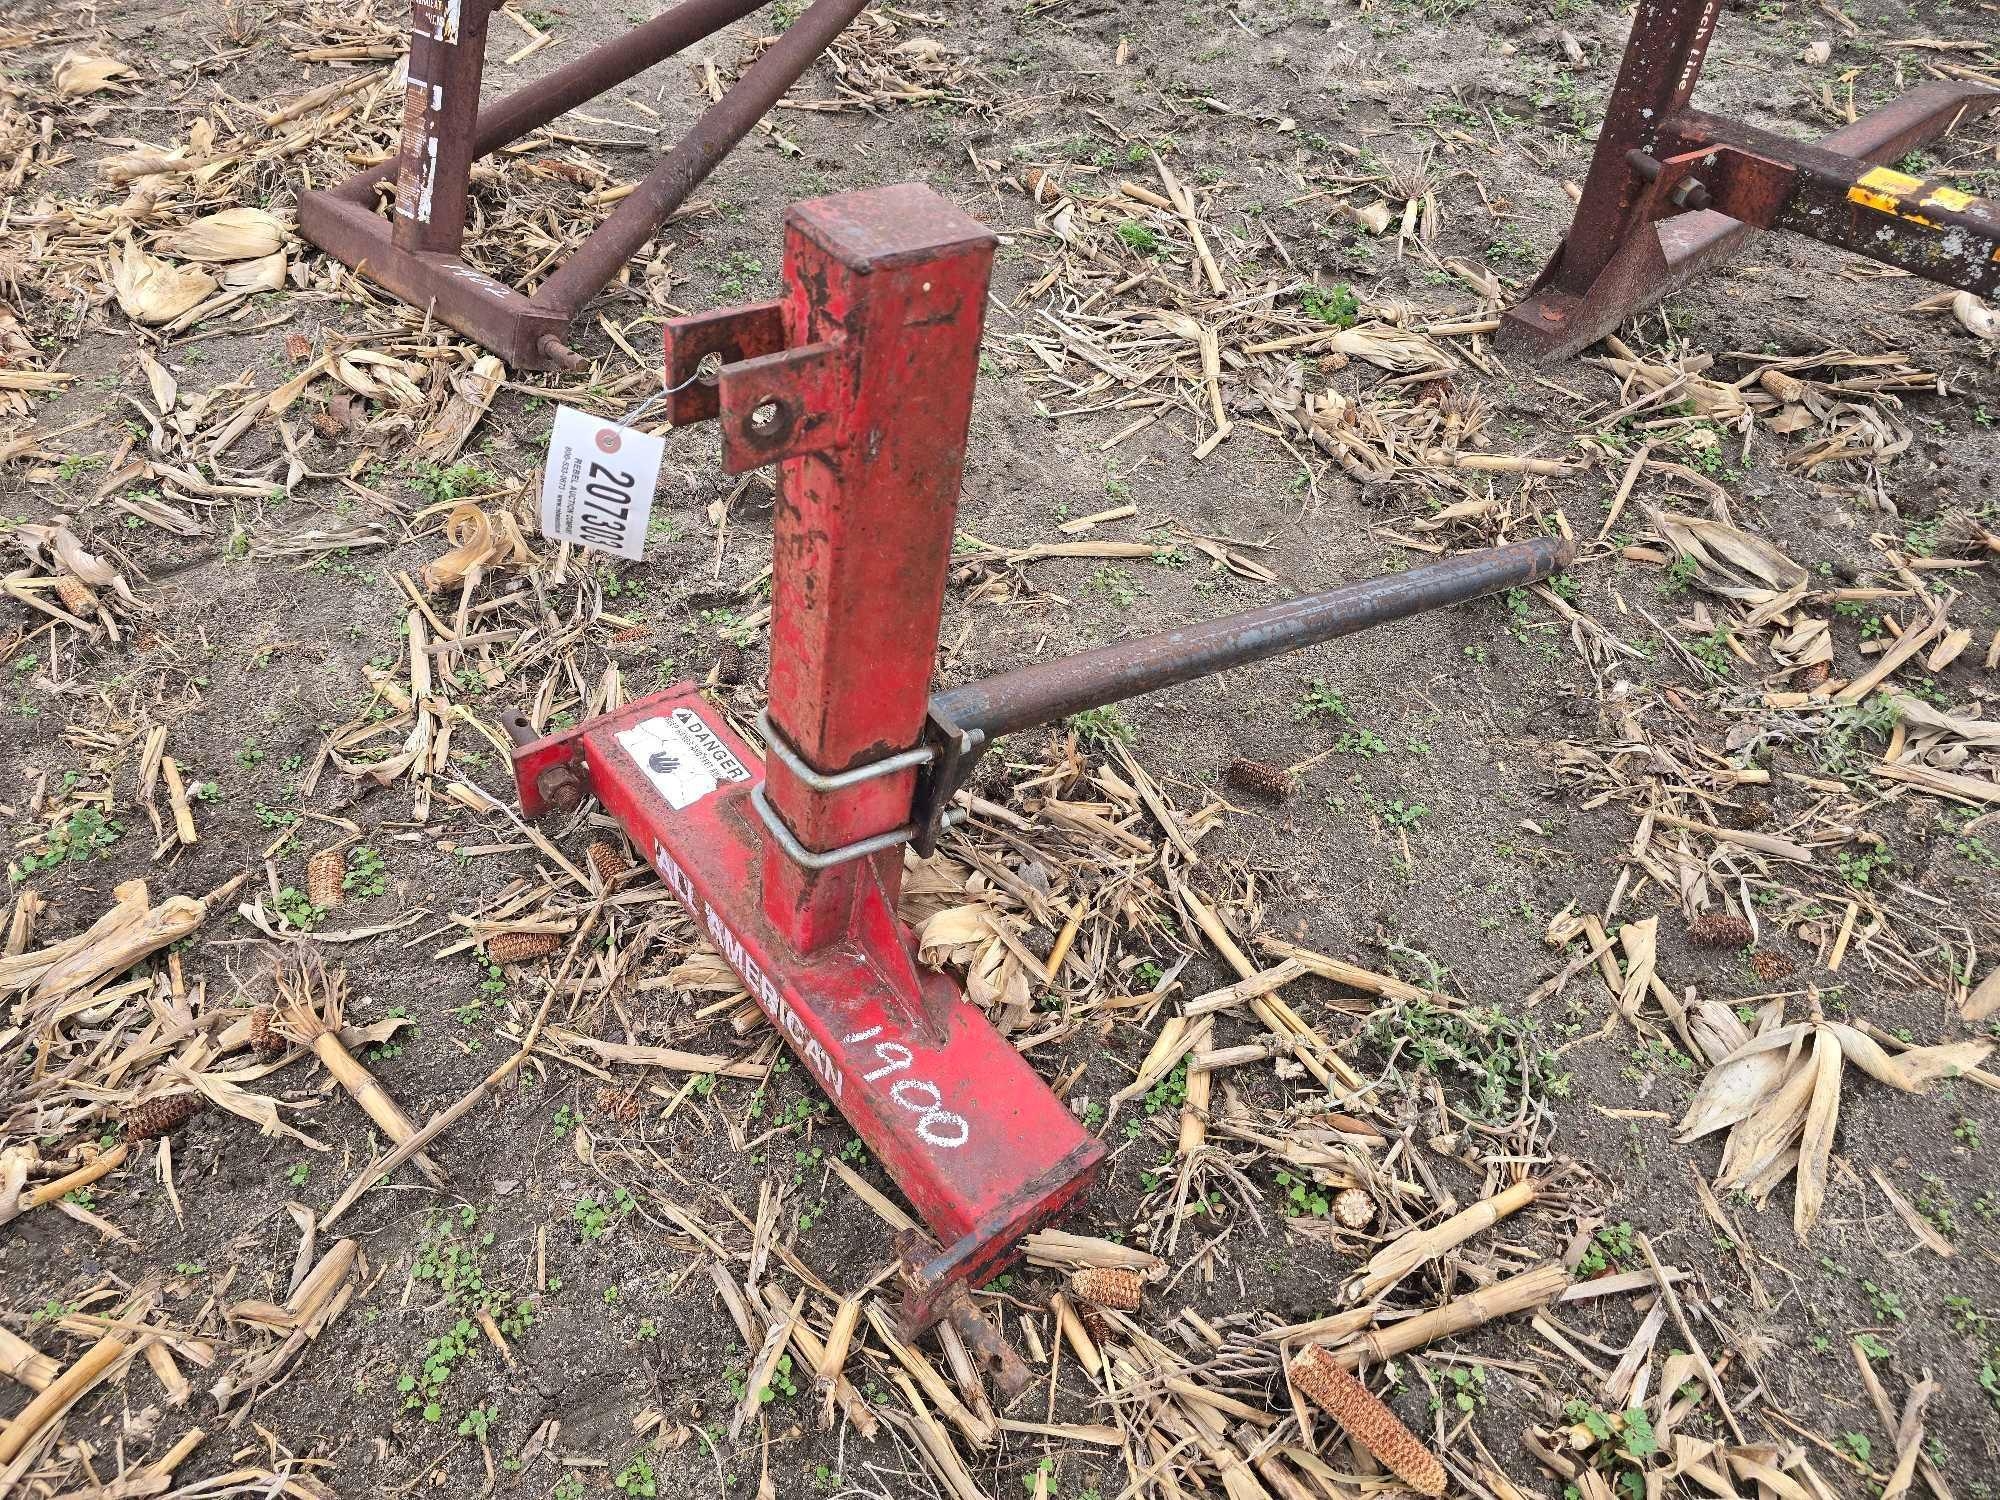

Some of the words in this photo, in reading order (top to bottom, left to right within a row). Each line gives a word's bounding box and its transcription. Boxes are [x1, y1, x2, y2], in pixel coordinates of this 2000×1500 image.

[566, 486, 577, 515] AUCTION
[570, 457, 583, 484] REBEL
[578, 461, 635, 550] 207303
[687, 721, 744, 780] DANGER
[654, 837, 700, 916] ALL
[704, 900, 844, 1098] AMERICAN
[841, 1025, 969, 1148] 1900
